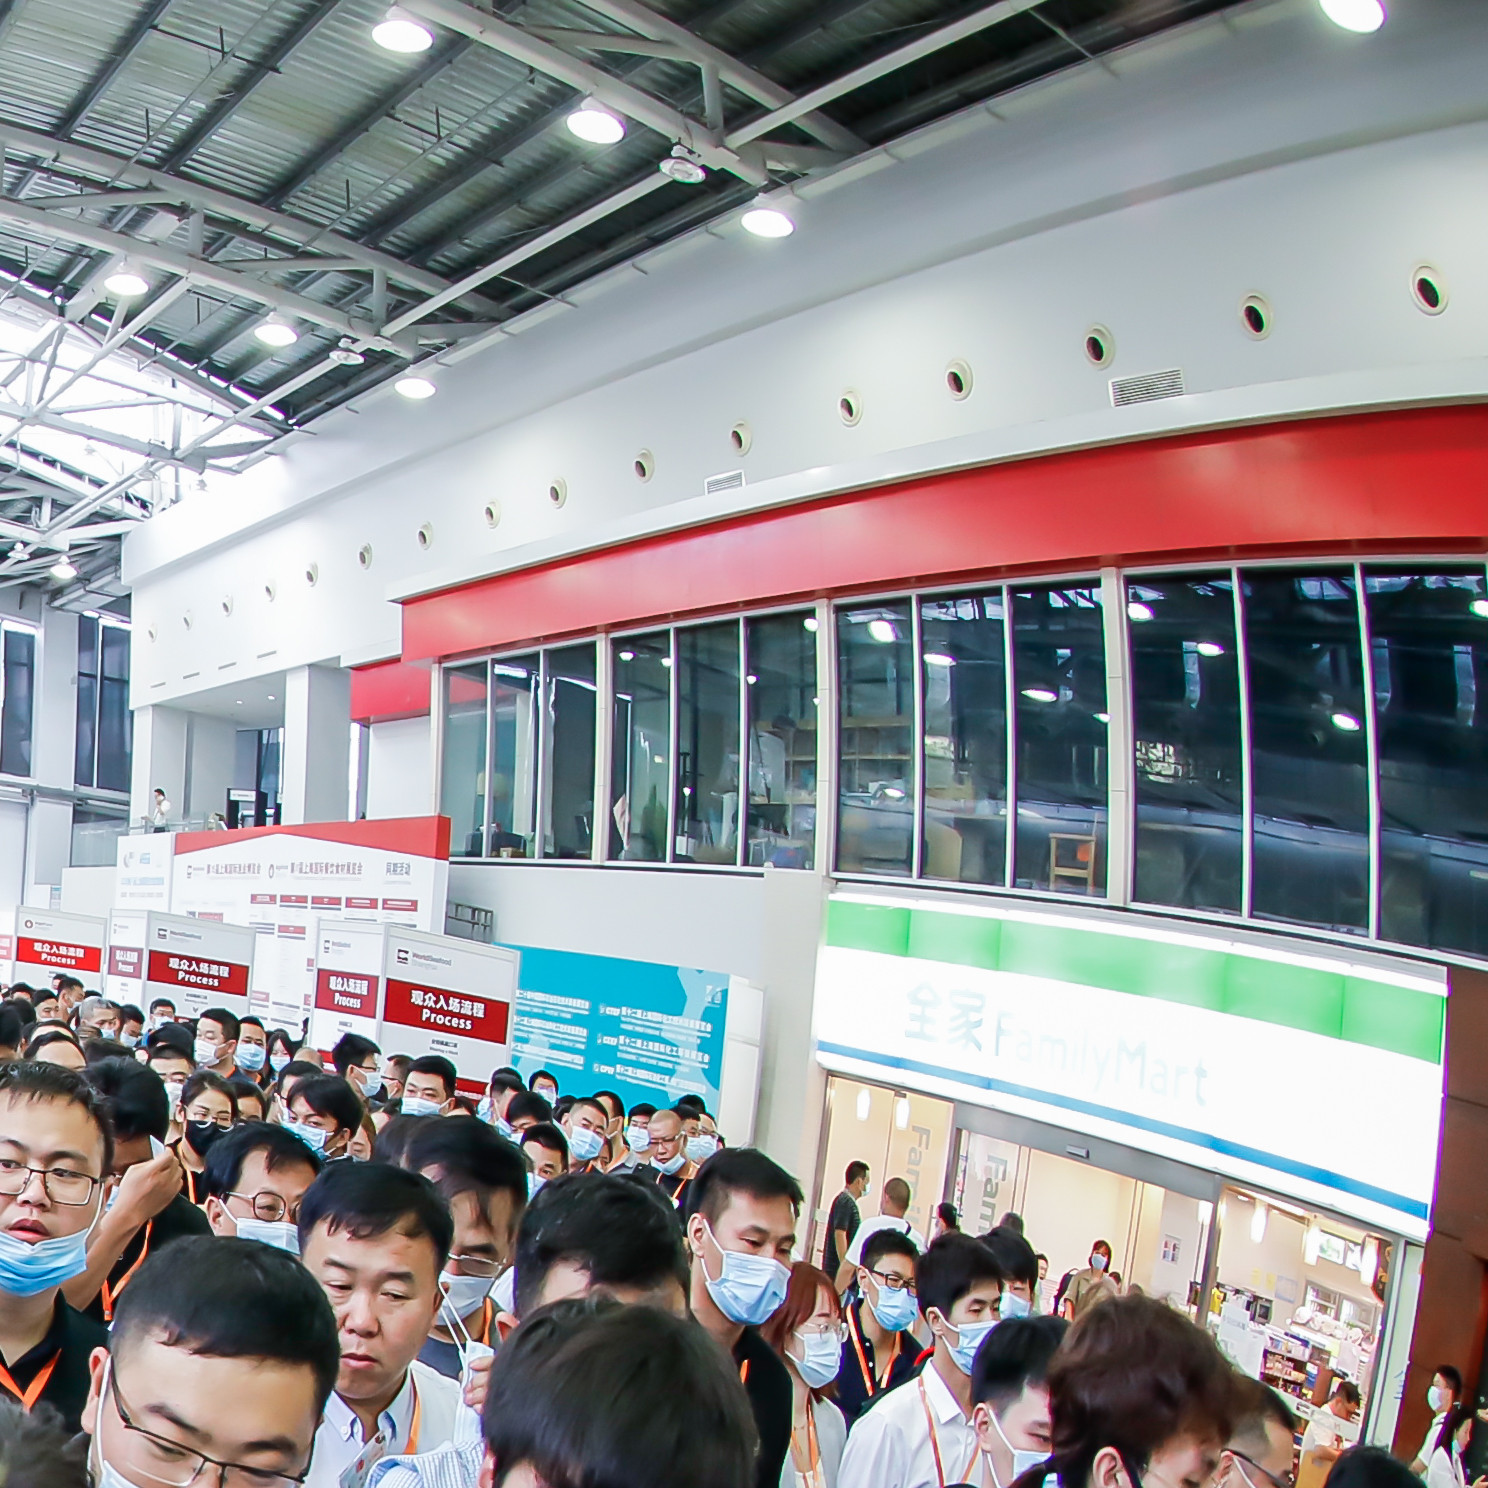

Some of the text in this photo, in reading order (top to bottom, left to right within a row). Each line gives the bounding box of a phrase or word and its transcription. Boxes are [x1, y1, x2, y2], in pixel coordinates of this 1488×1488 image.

[41, 953, 77, 966] Process
[169, 957, 230, 978] 观众入场流程
[178, 970, 220, 987] Process
[329, 976, 369, 996] 观众入场流程
[334, 993, 362, 1009] Process
[411, 990, 485, 1018] 观众入场流程
[422, 1009, 473, 1030] Process
[905, 982, 987, 1052] 全家
[994, 1009, 1209, 1106] FamilyMart
